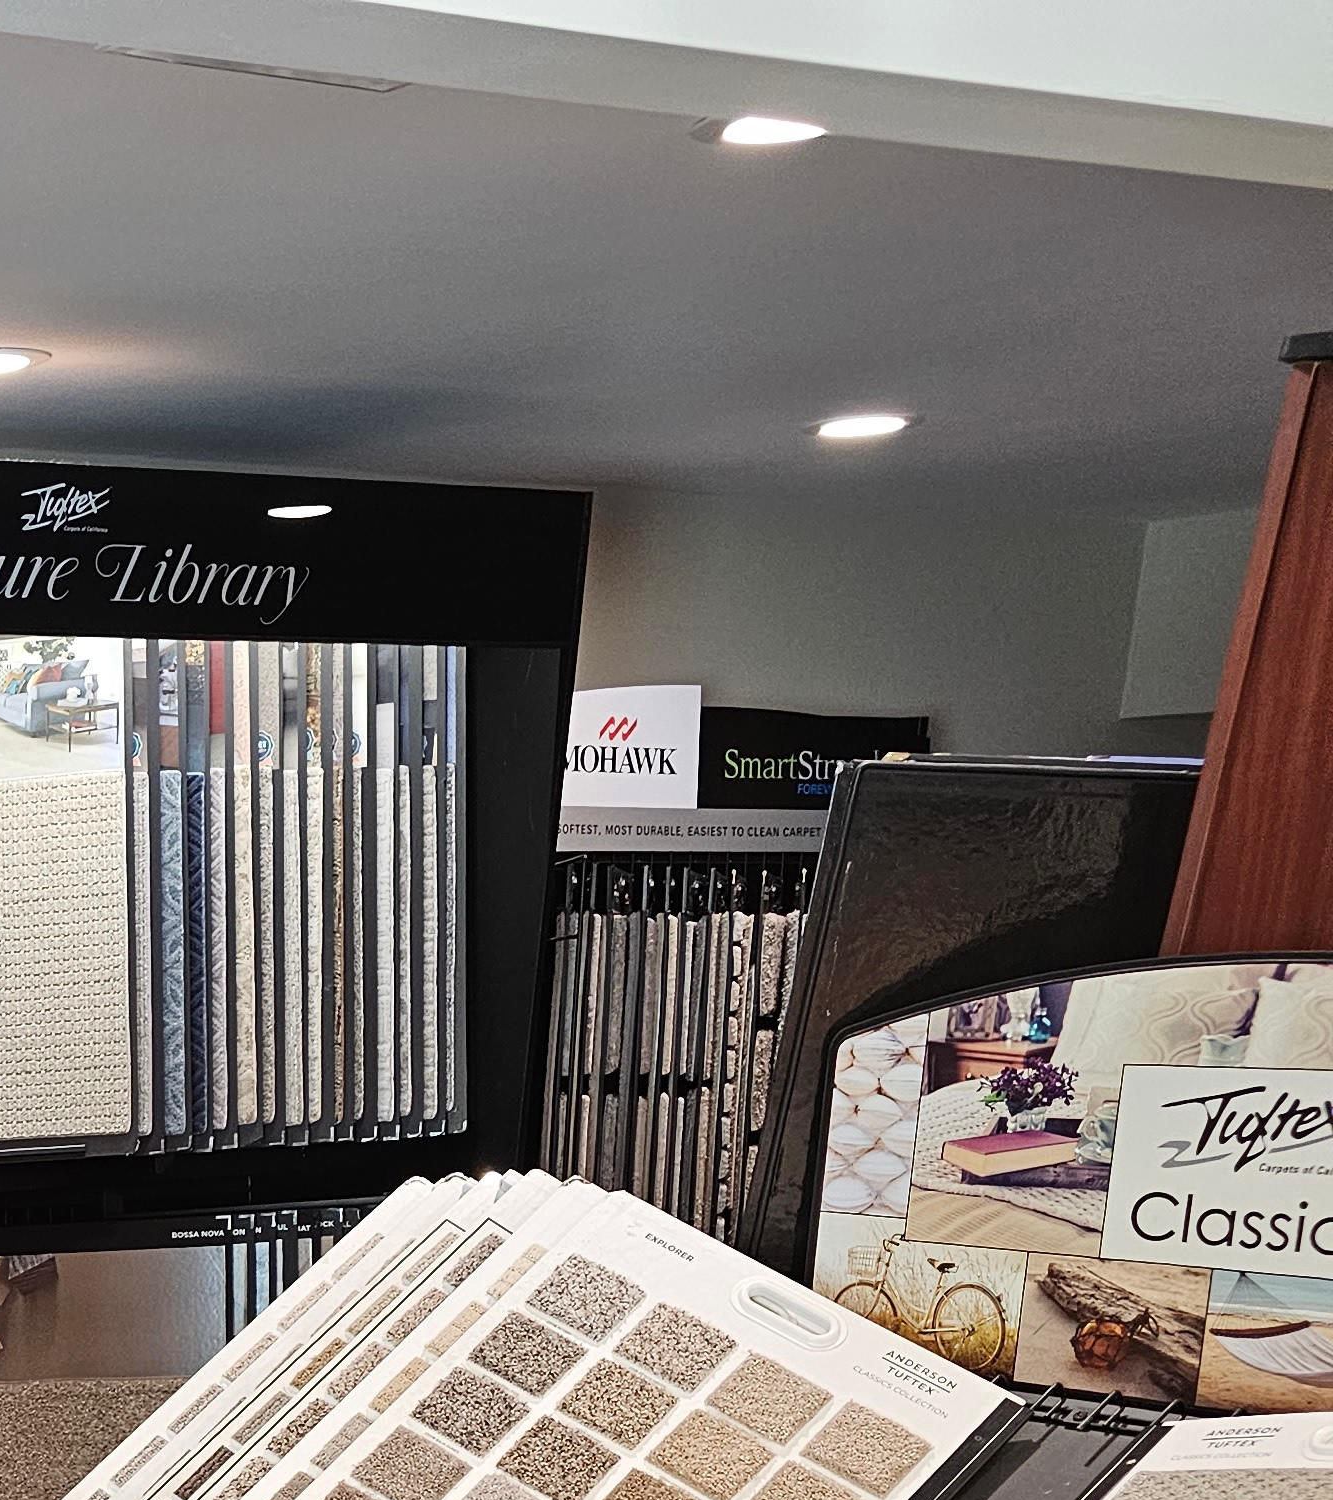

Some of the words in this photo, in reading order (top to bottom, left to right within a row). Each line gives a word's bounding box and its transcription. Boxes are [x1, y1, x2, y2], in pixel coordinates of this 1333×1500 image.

[21, 482, 113, 532] Tuftex
[95, 542, 311, 626] Library
[605, 825, 632, 837] MOST
[636, 825, 684, 839] DURABLE,
[687, 826, 728, 838] EASIEST
[732, 826, 744, 838] TO
[747, 826, 781, 838] CLEAN
[783, 827, 822, 838] CARPET
[1259, 1163, 1299, 1174] Carpets
[1302, 1165, 1314, 1174] of
[171, 1231, 199, 1239] BOSSA
[200, 1229, 225, 1238] NOVA
[644, 1232, 694, 1263] EXPLORER
[885, 1350, 958, 1390] ANDERSON
[887, 1365, 934, 1395] TUFTEX
[893, 1386, 949, 1419] COLLECTION
[1207, 1426, 1283, 1437] ANDERSON
[1207, 1439, 1257, 1449] TUFTEX
